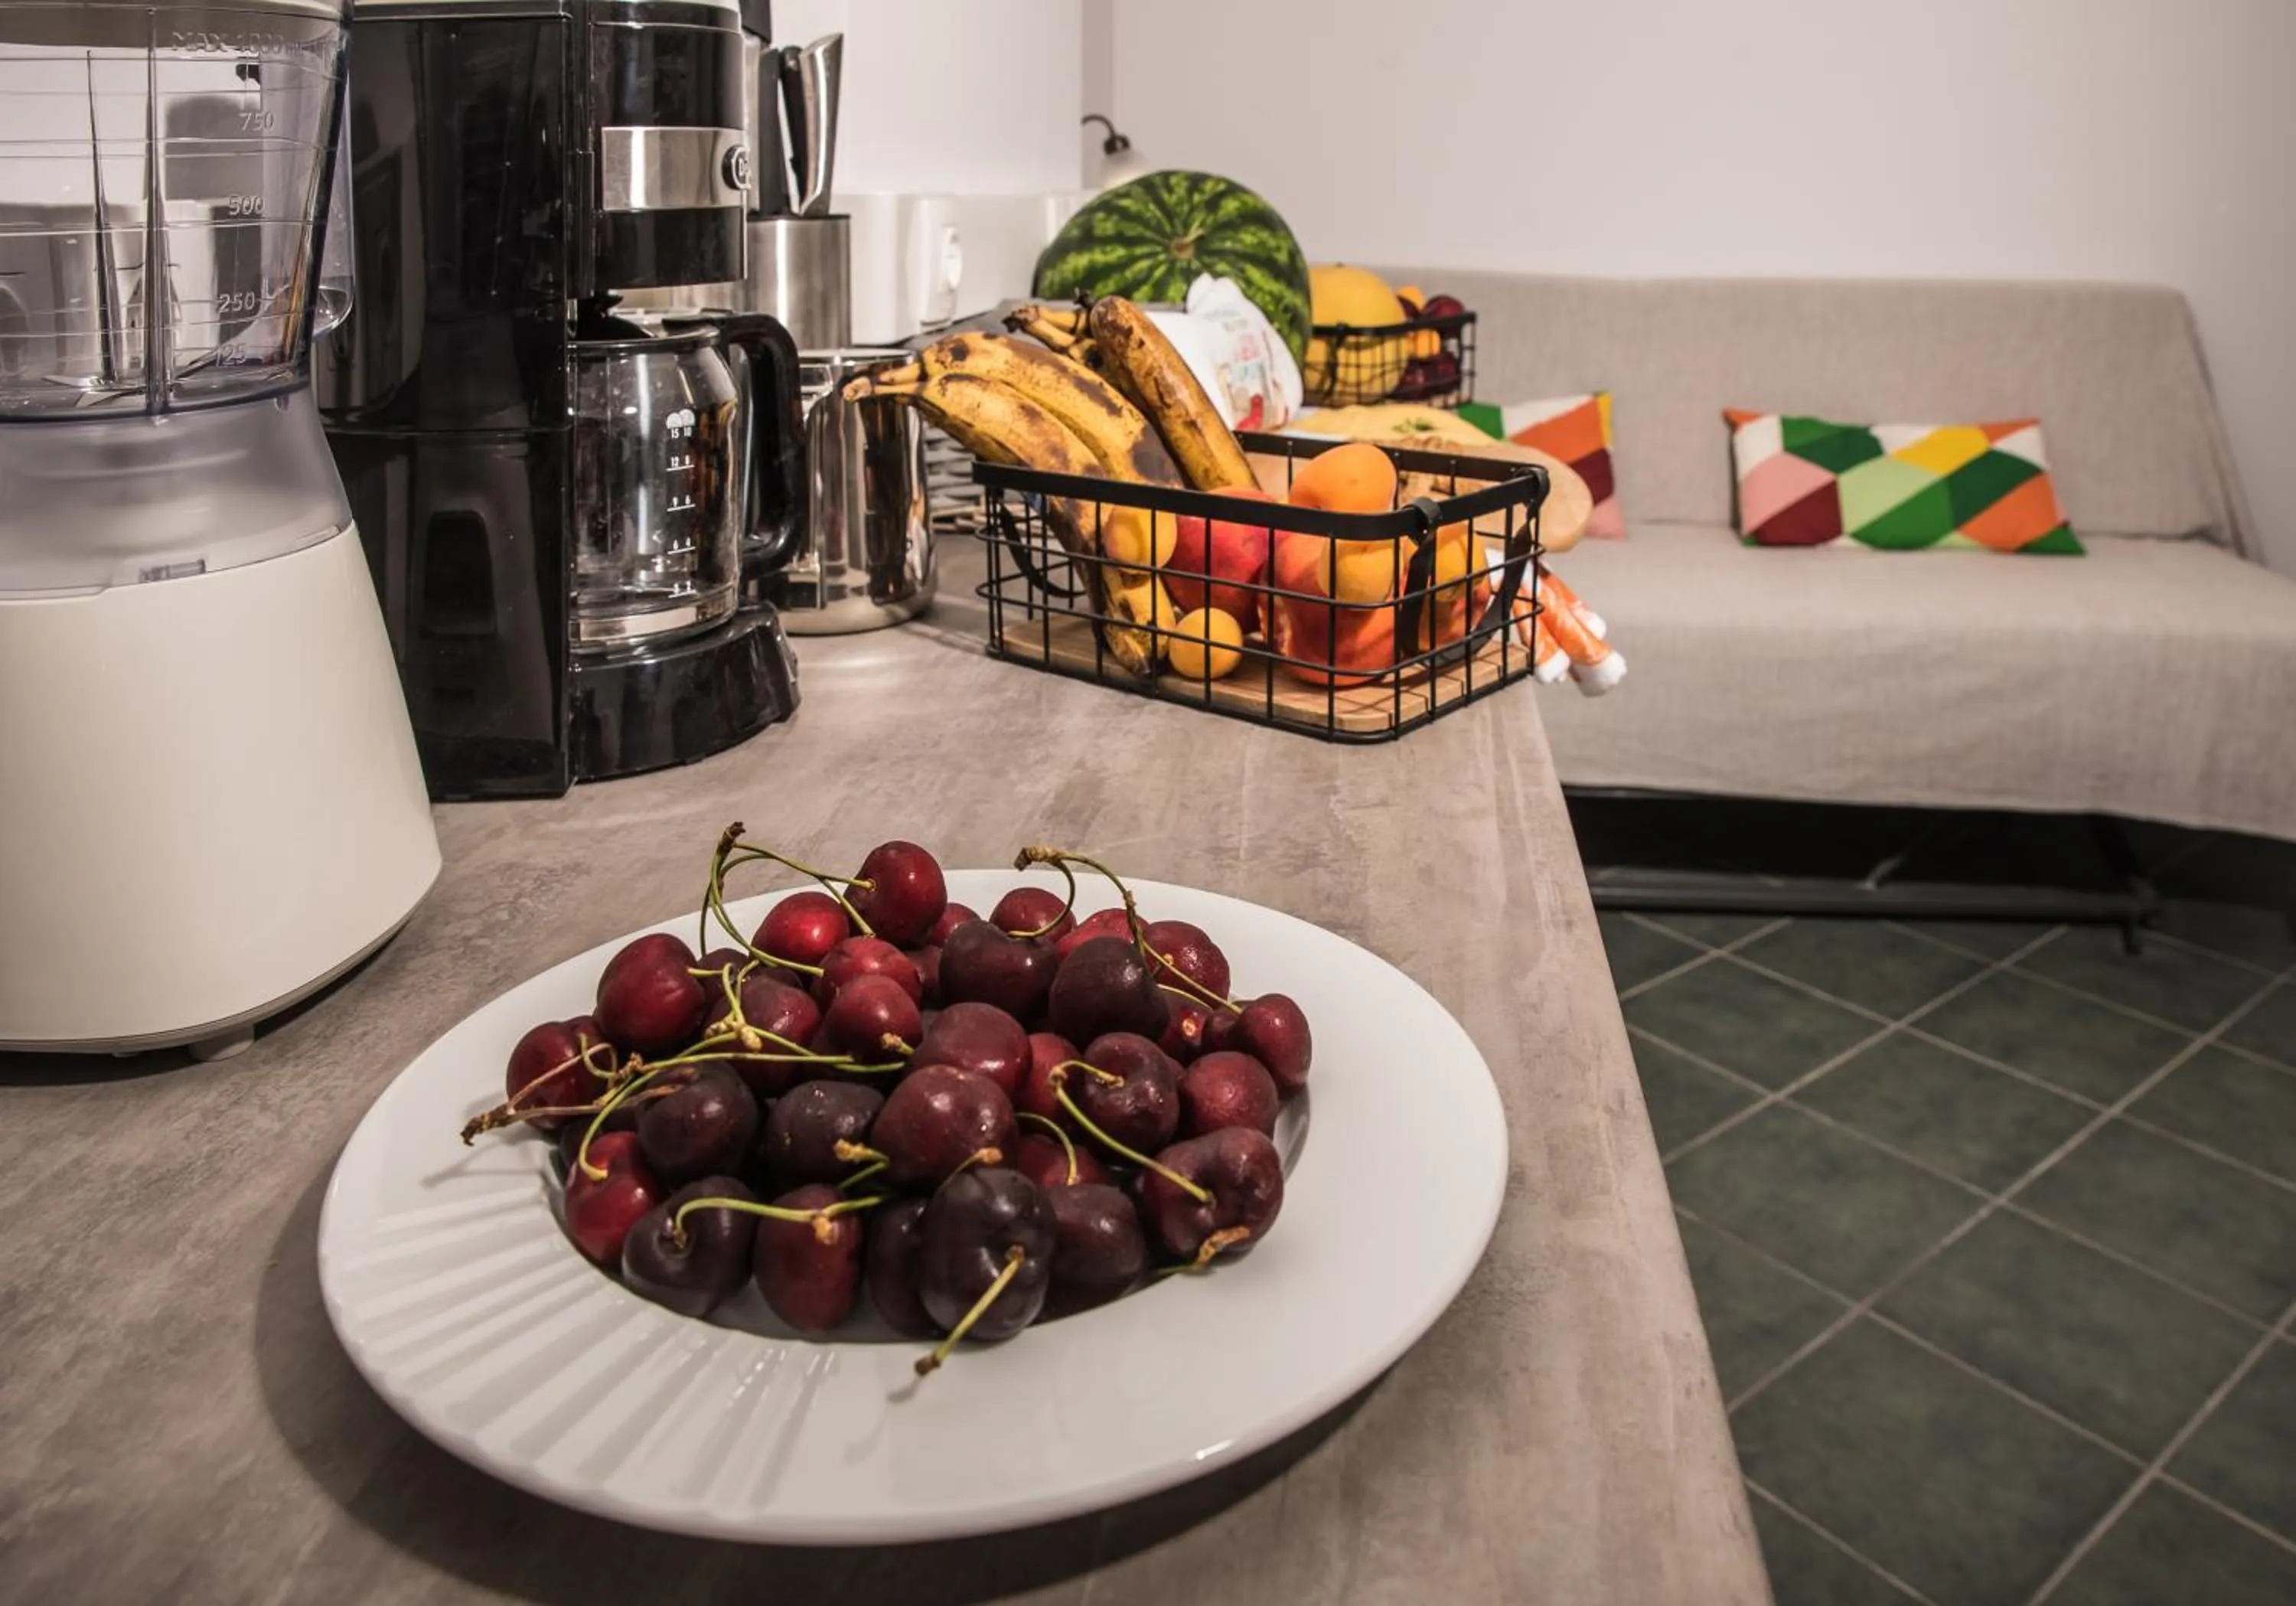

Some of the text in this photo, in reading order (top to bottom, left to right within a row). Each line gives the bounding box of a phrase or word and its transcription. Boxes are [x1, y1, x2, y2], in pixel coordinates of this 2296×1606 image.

[239, 111, 275, 132] 750
[228, 194, 266, 216] 500
[219, 291, 256, 313] 250
[671, 428, 680, 439] 15
[671, 455, 680, 466] 12
